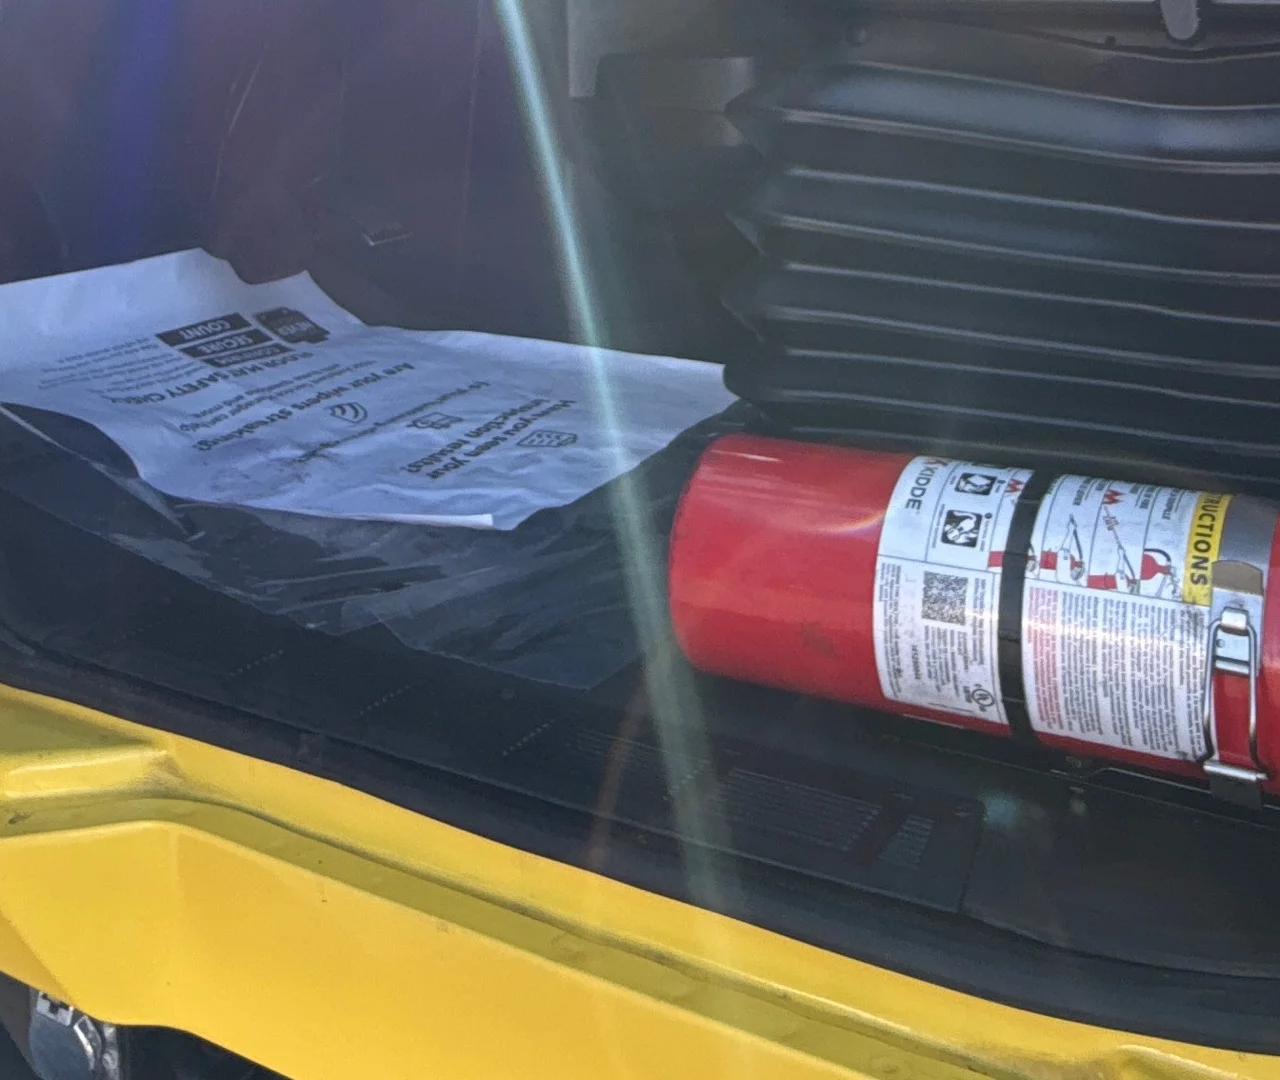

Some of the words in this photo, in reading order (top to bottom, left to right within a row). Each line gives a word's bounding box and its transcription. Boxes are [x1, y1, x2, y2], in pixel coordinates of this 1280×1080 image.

[179, 320, 232, 340] COUNT
[199, 335, 254, 354] SECURE
[382, 363, 415, 375] Are
[167, 372, 230, 398] SAFETY
[349, 373, 388, 388] your
[291, 387, 351, 410] wipers
[503, 416, 537, 436] you
[426, 457, 471, 479] your
[905, 466, 938, 510] KIDDE
